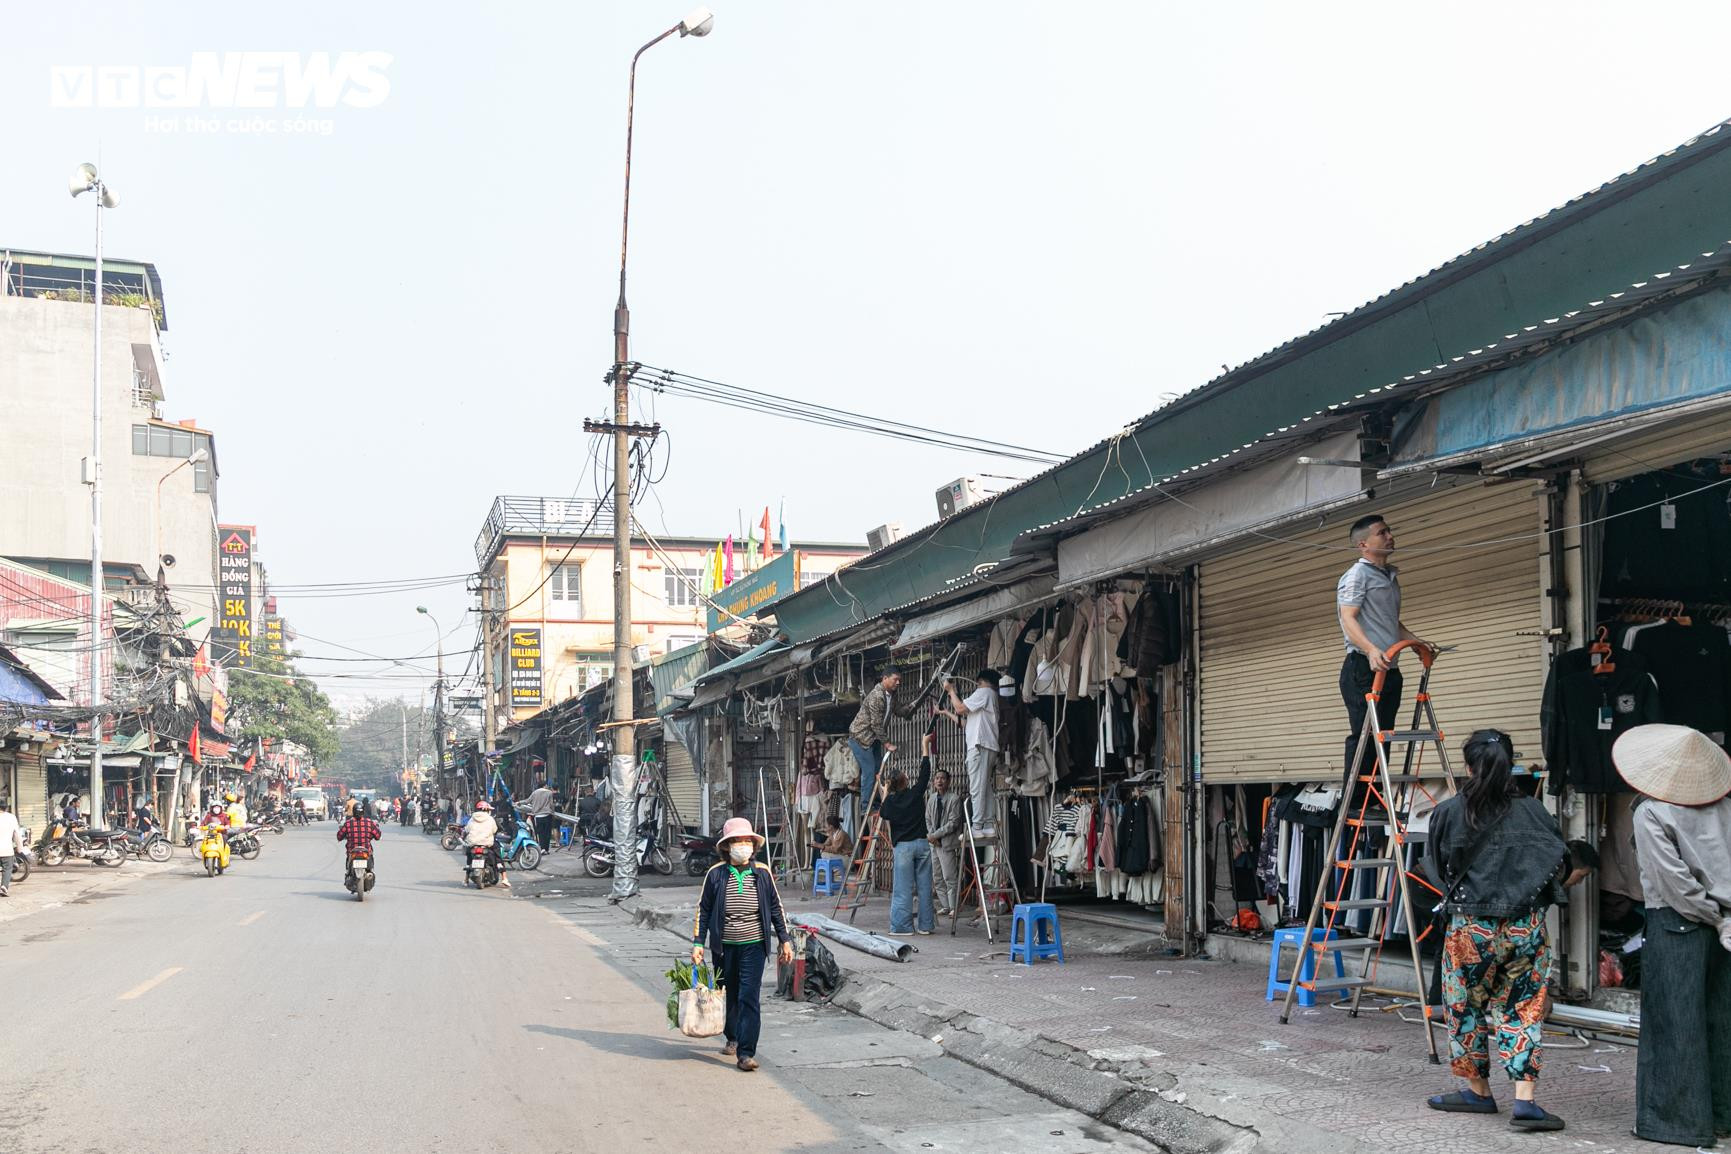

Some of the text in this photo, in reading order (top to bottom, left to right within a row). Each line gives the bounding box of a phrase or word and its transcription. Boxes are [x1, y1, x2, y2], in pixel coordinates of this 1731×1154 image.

[222, 555, 248, 567] HÀNG
[222, 568, 249, 582] ĐỒNG
[226, 583, 244, 595] GIÁ
[225, 600, 245, 616] 5K
[511, 648, 541, 657] BILLIARD
[517, 658, 535, 668] CLUB
